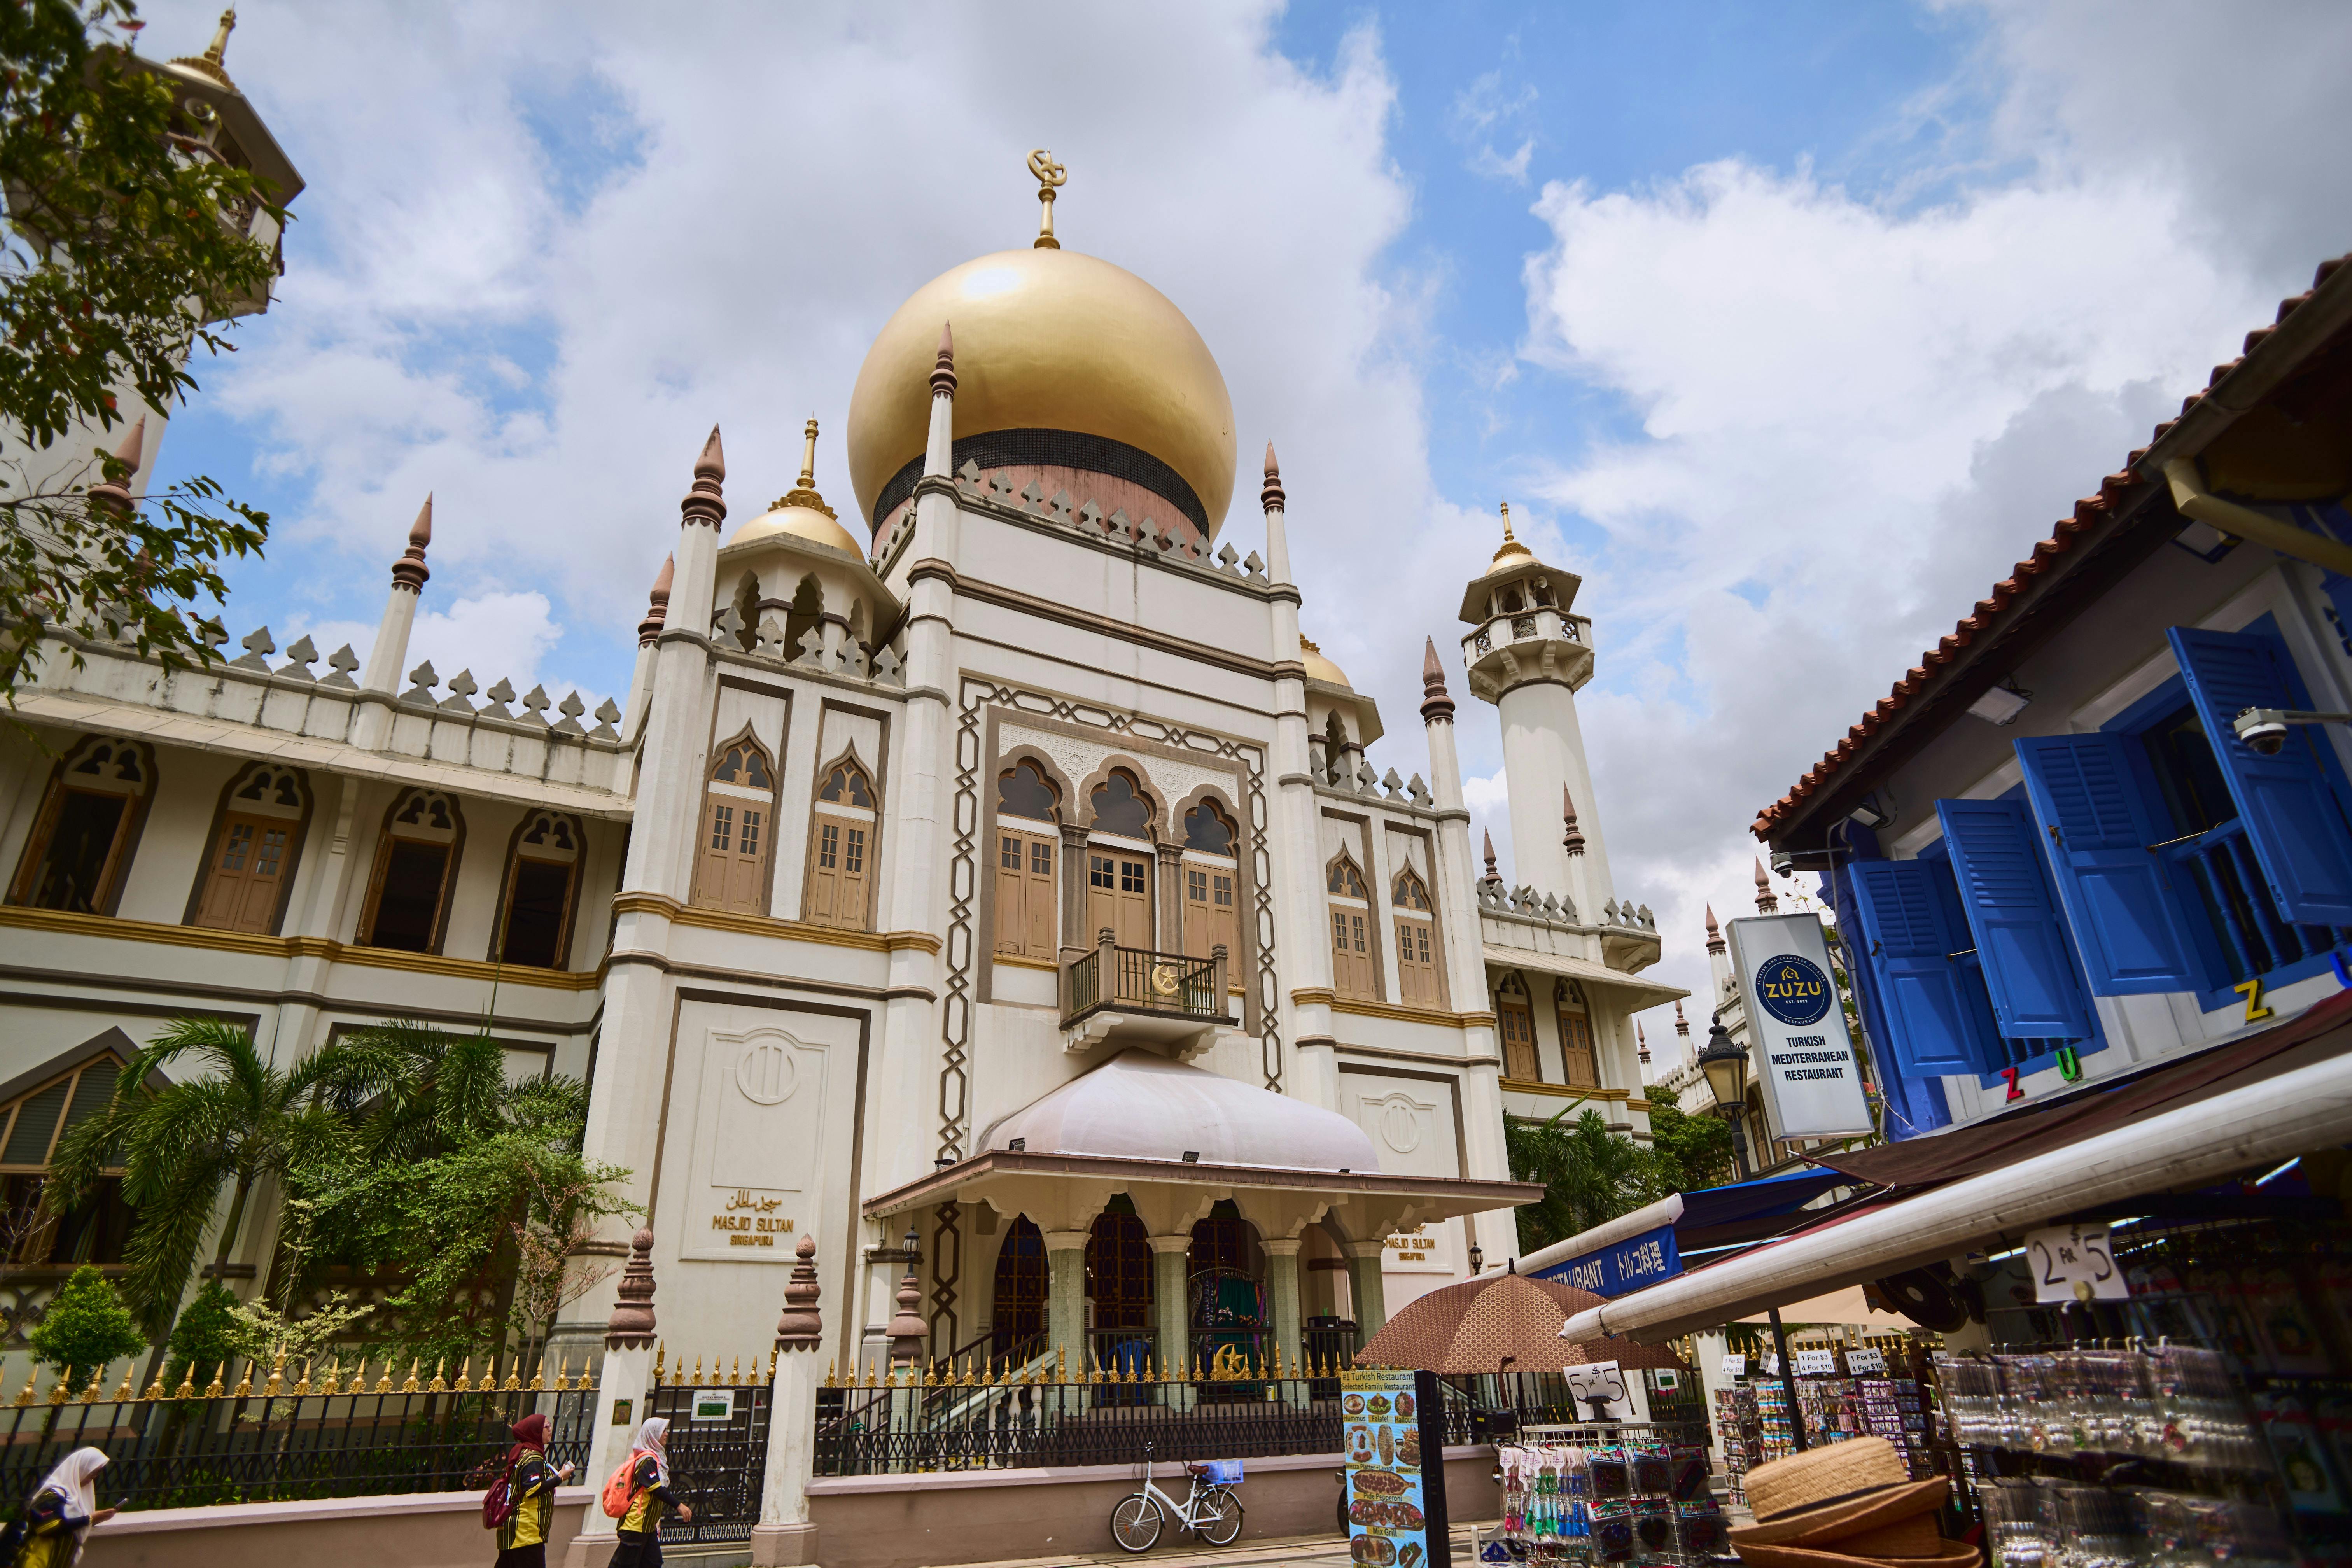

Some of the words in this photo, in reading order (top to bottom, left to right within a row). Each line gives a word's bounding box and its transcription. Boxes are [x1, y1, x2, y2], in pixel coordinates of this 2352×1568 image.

[1757, 966, 1768, 985] TURKISH
[1809, 963, 1826, 982] CUISINE
[1765, 981, 1821, 998] ZUZU
[1784, 1016, 1817, 1024] RESTAURANT
[1786, 1035, 1826, 1047] TURKISH
[1771, 1050, 1849, 1065] MEDITERRANEAN
[1784, 1068, 1843, 1081] RESTAURANT
[726, 1189, 758, 1210] سلطان
[712, 1215, 751, 1231] MASJID
[756, 1218, 794, 1232] SULTAN
[730, 1234, 774, 1246] SINGAPURA
[1385, 1237, 1409, 1249] MASJID
[1412, 1238, 1435, 1249] SULTAN
[1398, 1252, 1426, 1261] SINGAPURA
[1617, 1241, 1666, 1281] トルコ料理
[2033, 1240, 2067, 1286] 2
[1377, 1372, 1414, 1381] Restaurant
[1365, 1383, 1383, 1391] Family
[1373, 1527, 1383, 1535] Mix
[1384, 1528, 1397, 1537] Grill
